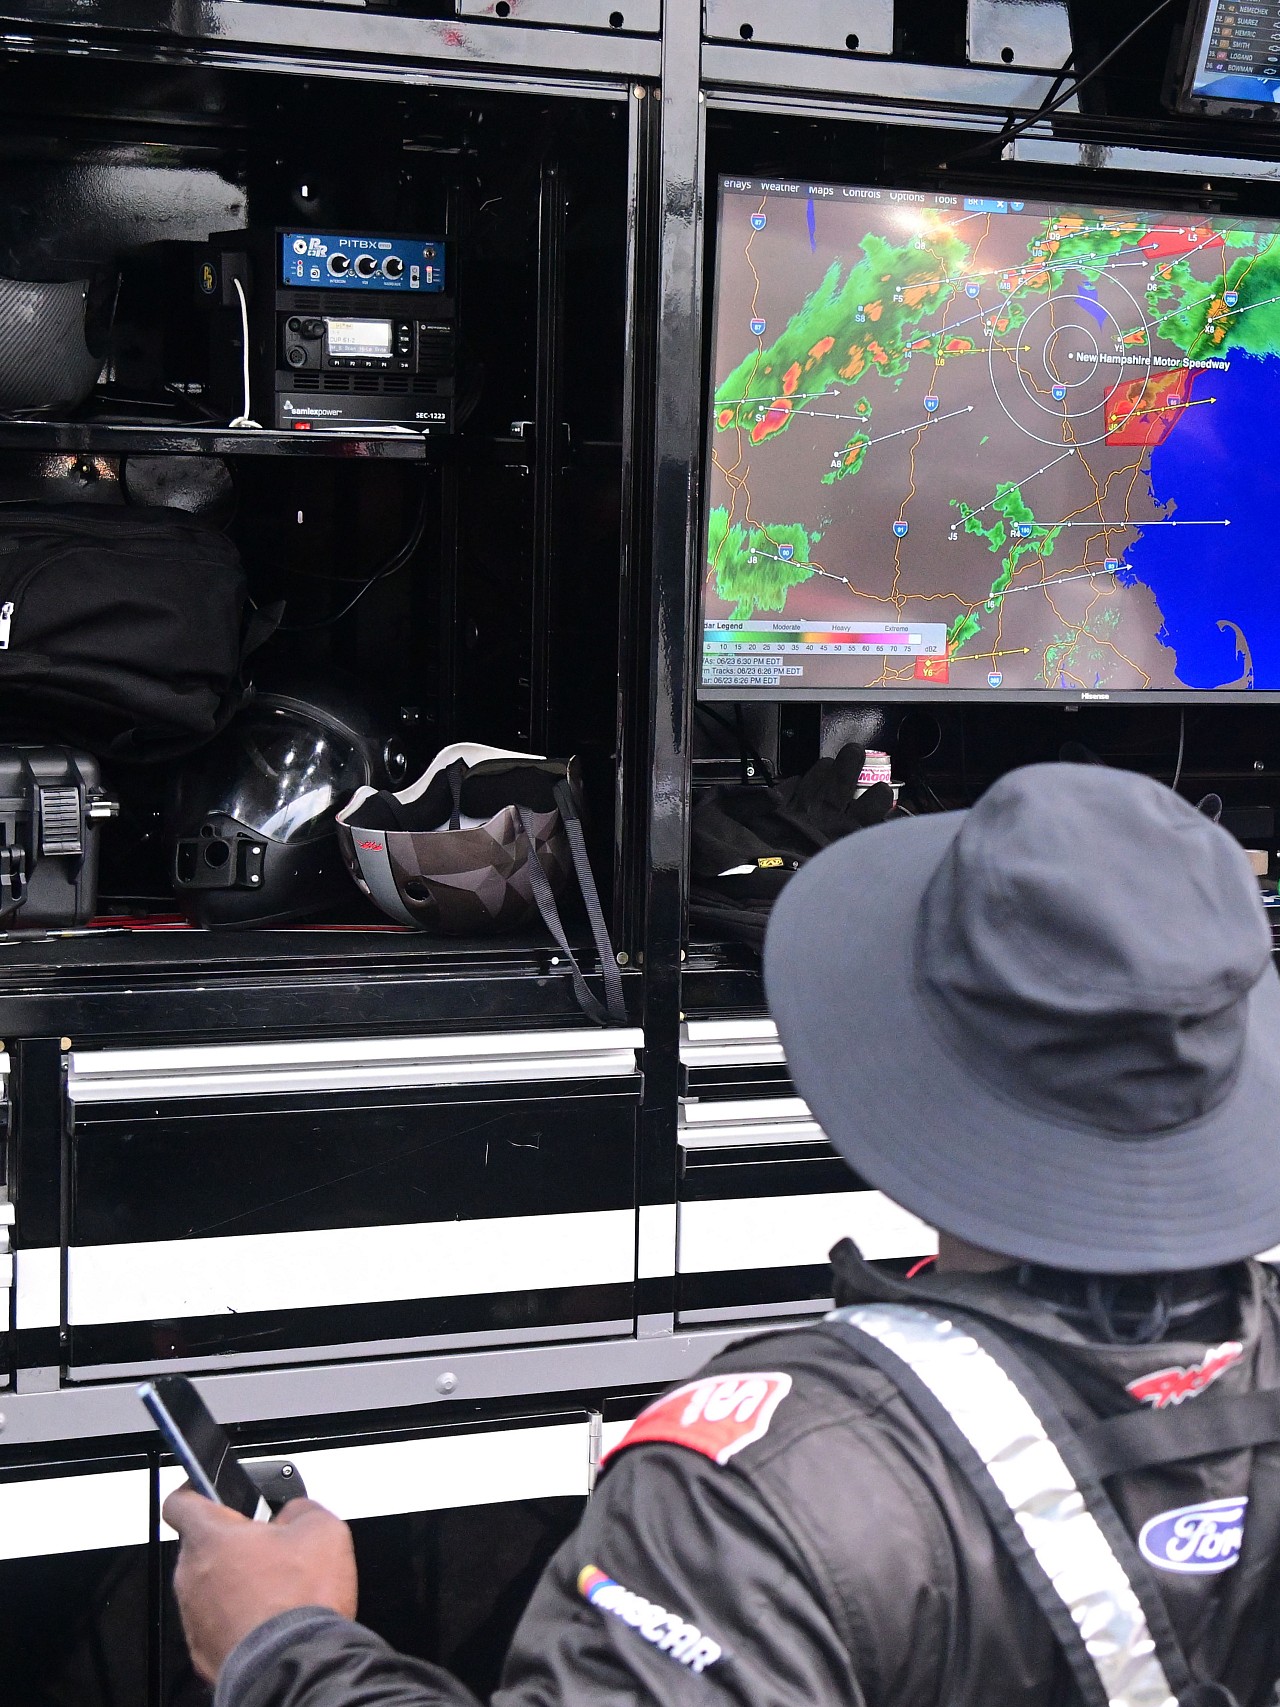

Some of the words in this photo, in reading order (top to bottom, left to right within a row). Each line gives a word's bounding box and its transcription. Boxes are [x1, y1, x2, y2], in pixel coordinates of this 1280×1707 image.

[1234, 30, 1257, 38] HEMRIC
[1232, 41, 1251, 49] SMITH
[1230, 53, 1253, 61] LOGANO
[1228, 64, 1254, 73] BOWMAN
[808, 186, 834, 196] Maps
[339, 239, 377, 249] PITBX
[893, 295, 904, 303] F5
[1076, 352, 1097, 362] New
[1099, 354, 1151, 367] Hampshire
[1153, 357, 1180, 367] Motor
[1182, 358, 1231, 371] Speedway
[756, 414, 766, 422] S1
[830, 460, 842, 468] A8
[948, 533, 958, 541] J5
[716, 657, 736, 665] 06/23
[737, 667, 756, 675] 06/23
[713, 676, 732, 684] 06/23
[1081, 692, 1110, 700] Hisense
[1165, 1507, 1244, 1562] For
